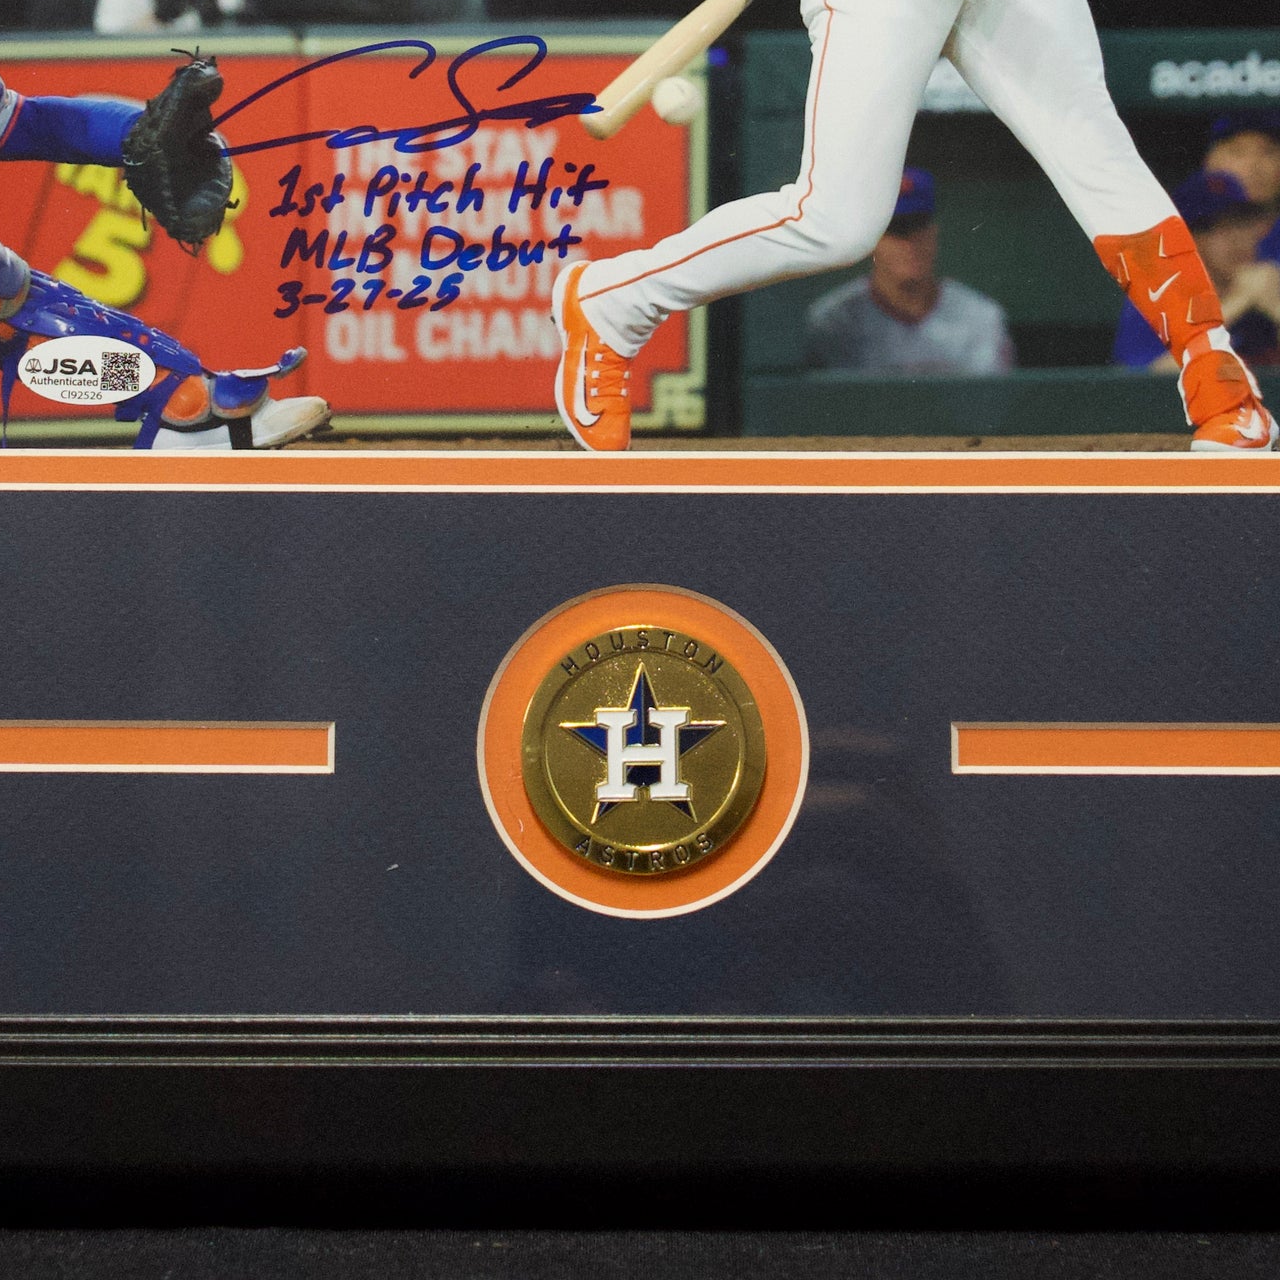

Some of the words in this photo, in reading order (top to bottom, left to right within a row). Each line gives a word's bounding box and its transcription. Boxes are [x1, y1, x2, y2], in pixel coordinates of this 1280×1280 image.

[434, 126, 559, 178] STAY
[269, 164, 345, 218] 1st
[363, 162, 485, 217] Pitch
[508, 157, 610, 214] Hit
[542, 187, 645, 240] CAR
[280, 223, 397, 273] MLB
[420, 223, 583, 272] Debut
[273, 271, 465, 319] 3-27-25
[325, 308, 406, 362] OIL
[415, 308, 564, 361] CHAN
[30, 376, 99, 387] Authenticated
[42, 358, 98, 376] JSA
[559, 630, 724, 677] HOUSTON
[595, 707, 693, 802] H
[575, 832, 715, 870] ASTROS
